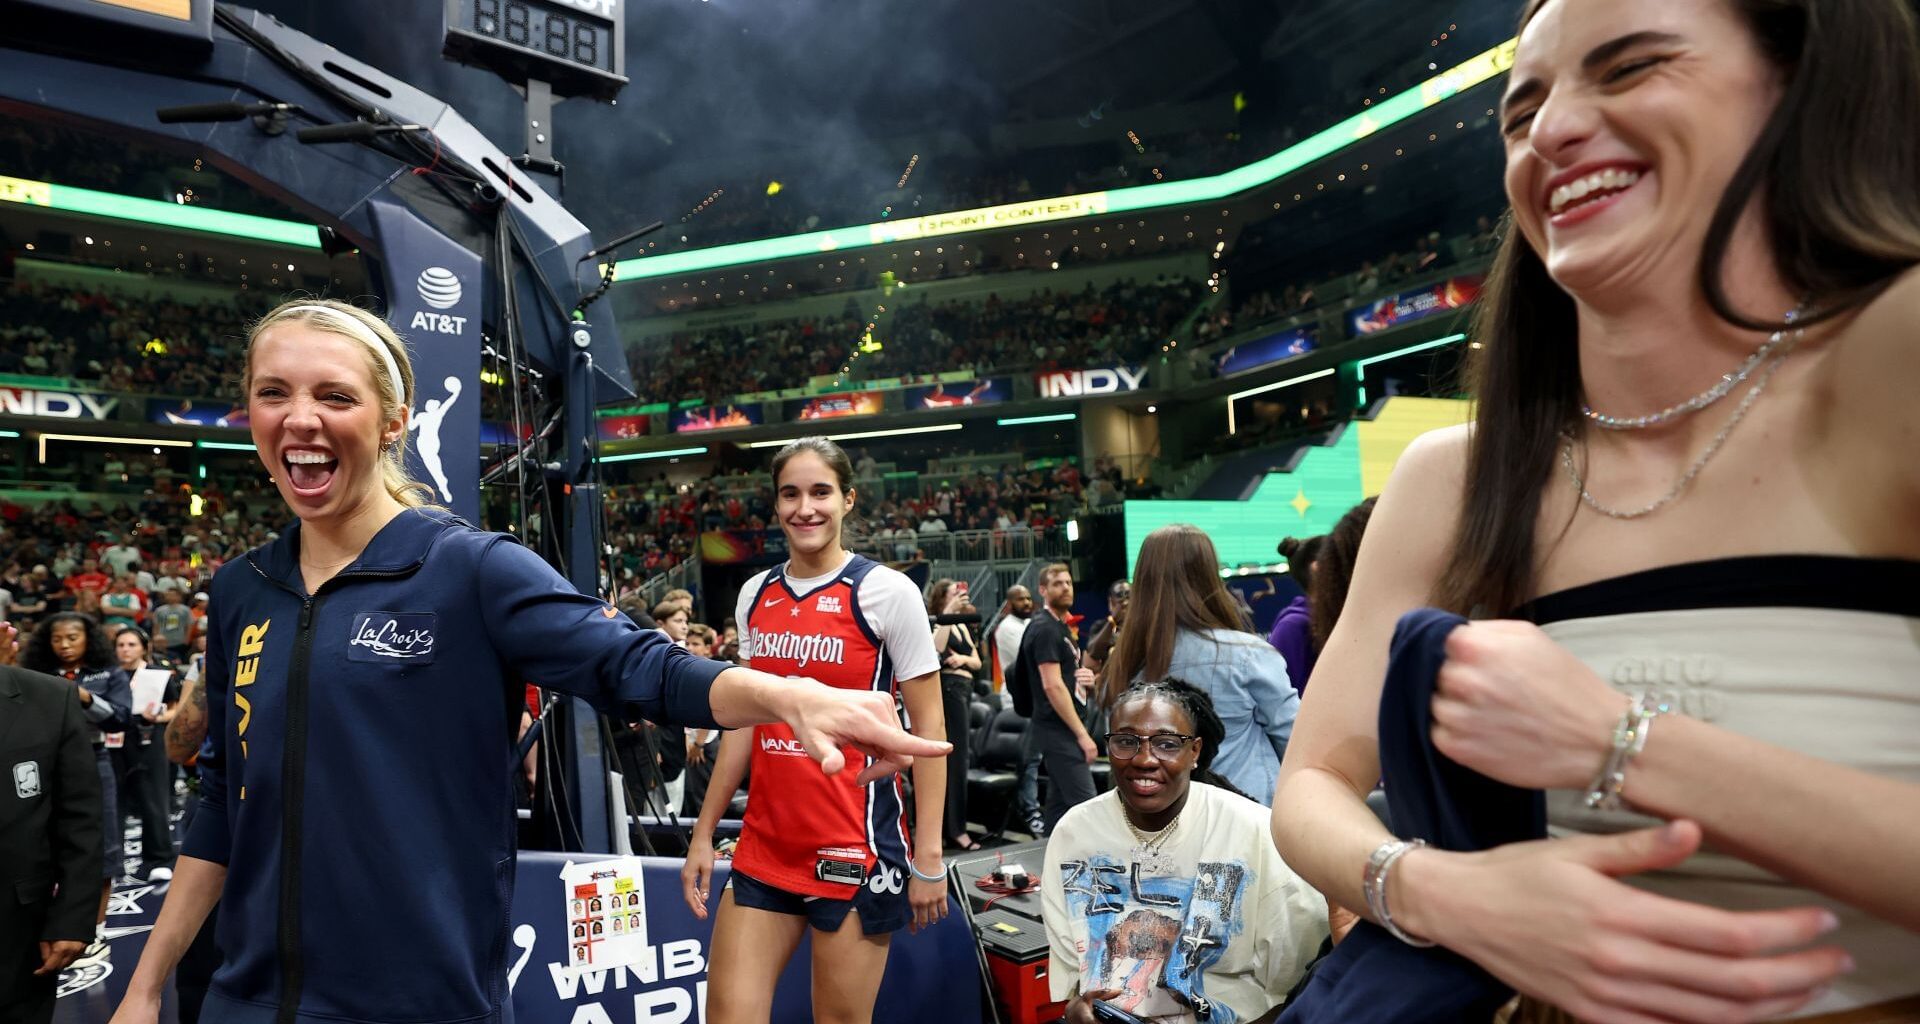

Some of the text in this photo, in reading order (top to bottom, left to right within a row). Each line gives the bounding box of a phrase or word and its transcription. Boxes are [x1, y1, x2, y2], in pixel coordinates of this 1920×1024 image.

[994, 201, 1081, 220] CONTEST
[410, 310, 468, 335] AT&T
[1039, 366, 1149, 398] INDY
[350, 617, 434, 657] LaCroix
[548, 938, 709, 1000] WNB
